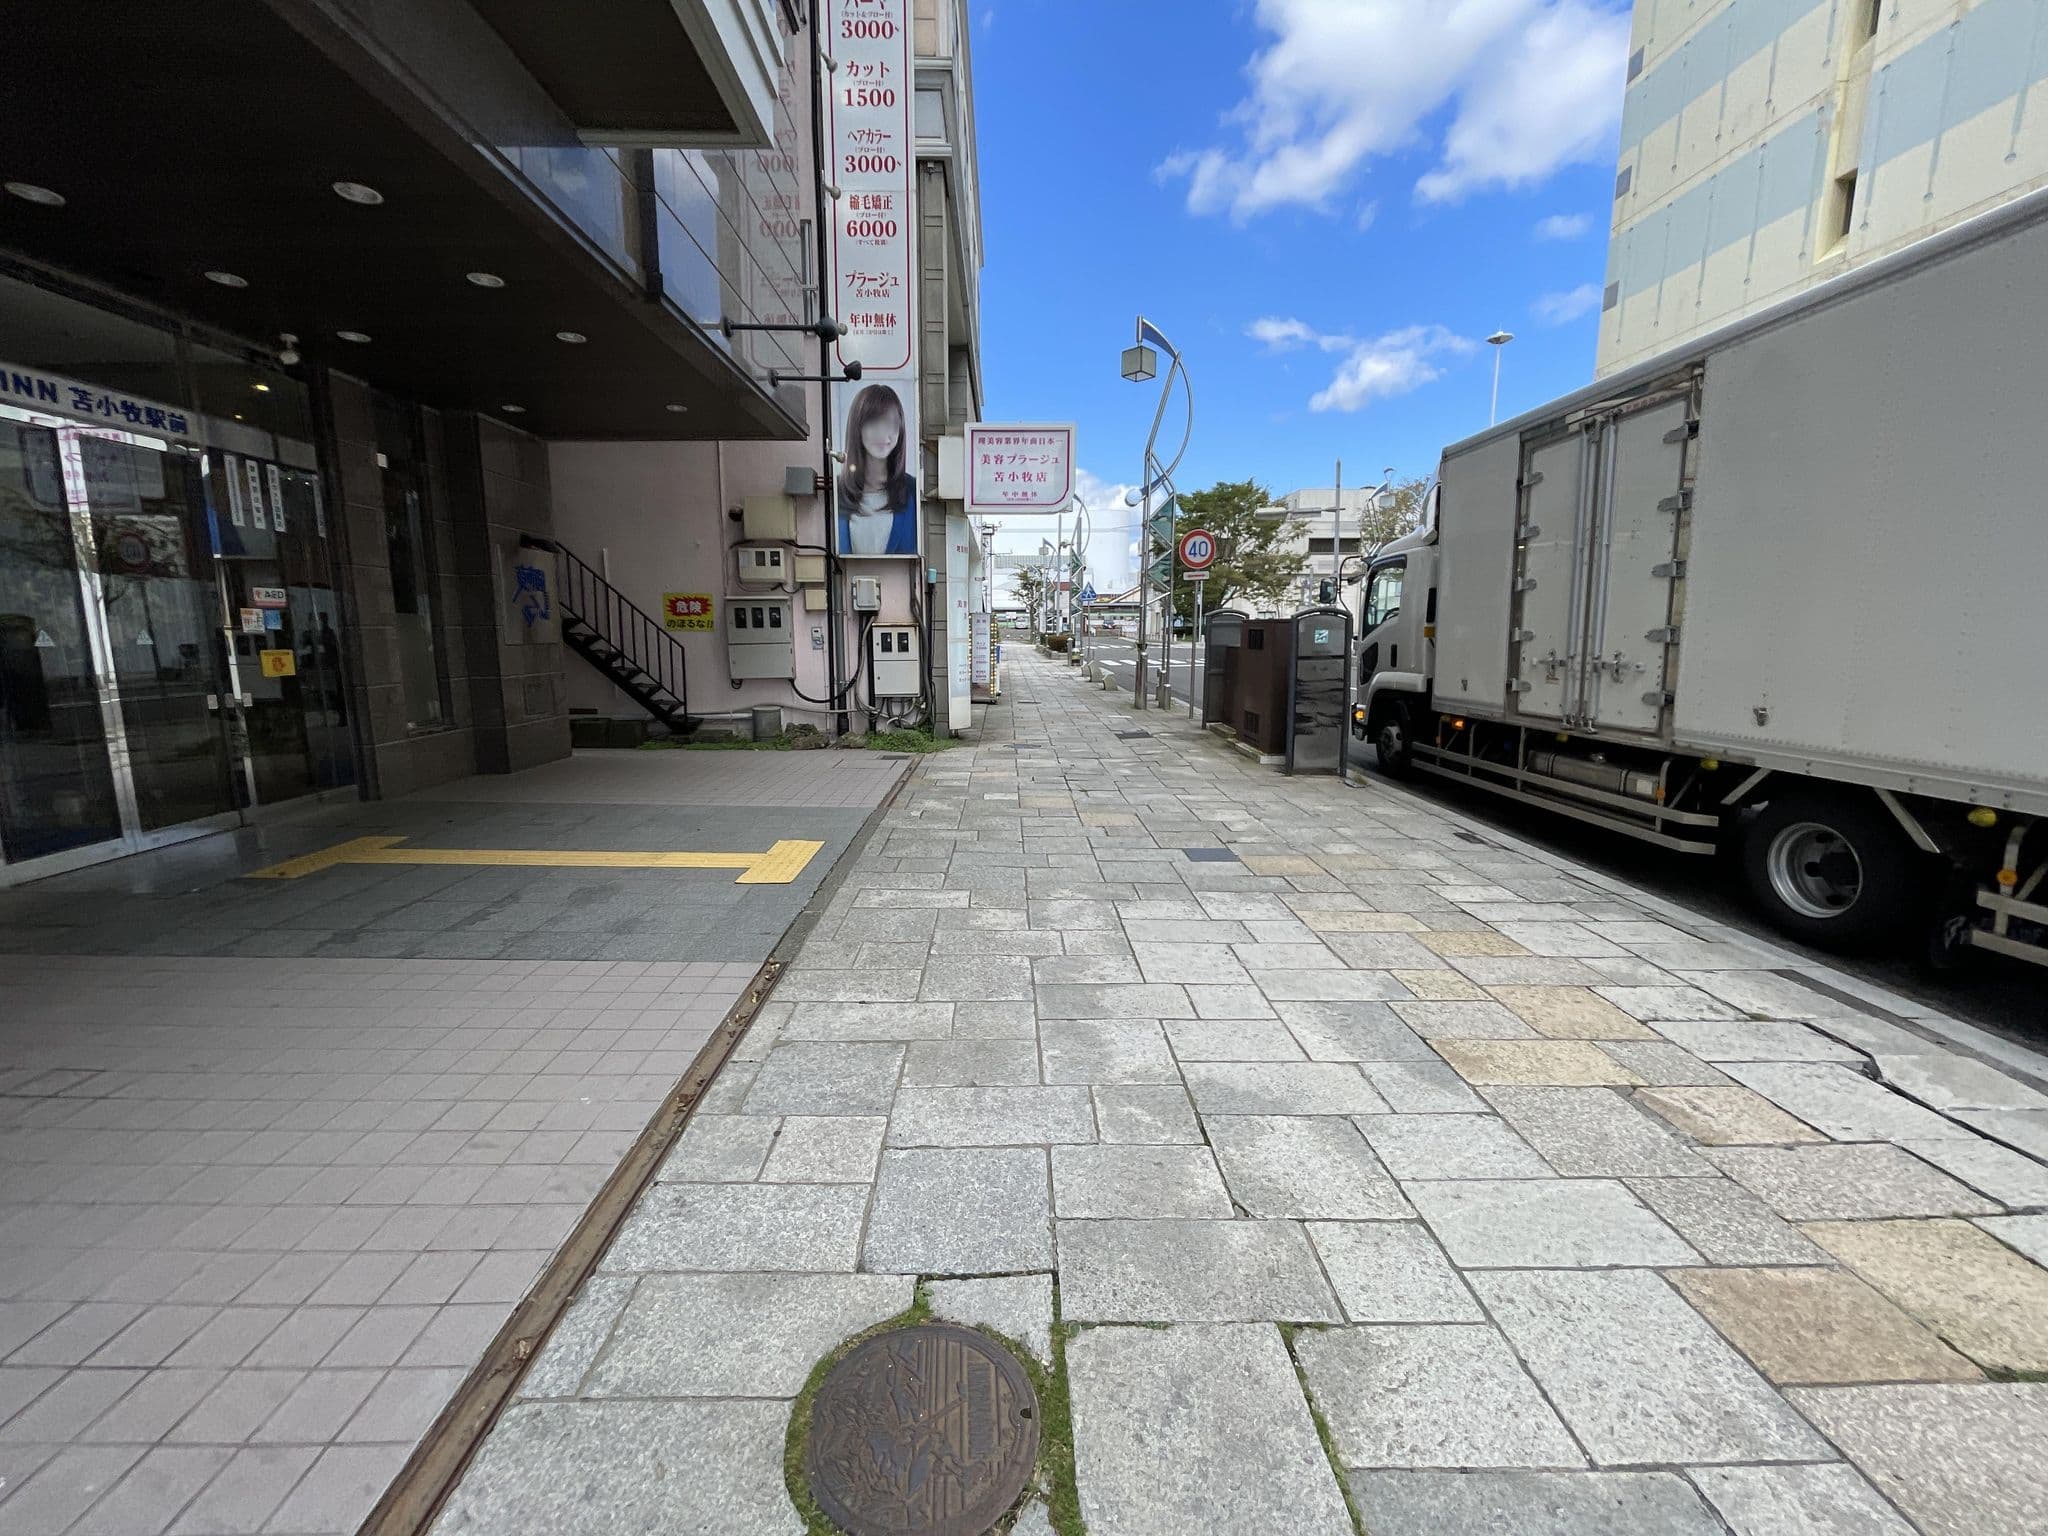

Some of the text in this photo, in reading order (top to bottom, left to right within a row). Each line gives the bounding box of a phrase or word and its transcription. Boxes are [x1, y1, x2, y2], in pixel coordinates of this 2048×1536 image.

[847, 61, 890, 78] カット
[844, 89, 895, 107] 1500
[848, 128, 891, 144] ヘアカラー
[850, 194, 893, 210] 縮毛矯正
[847, 220, 898, 237] 6000
[855, 289, 890, 298] 苫小牧店
[850, 313, 897, 328] 年中無休
[68, 386, 188, 434] 苫小牧駅前
[994, 472, 1047, 483] 苫小牧店
[1188, 541, 1208, 558] 40
[676, 600, 702, 613] 危険
